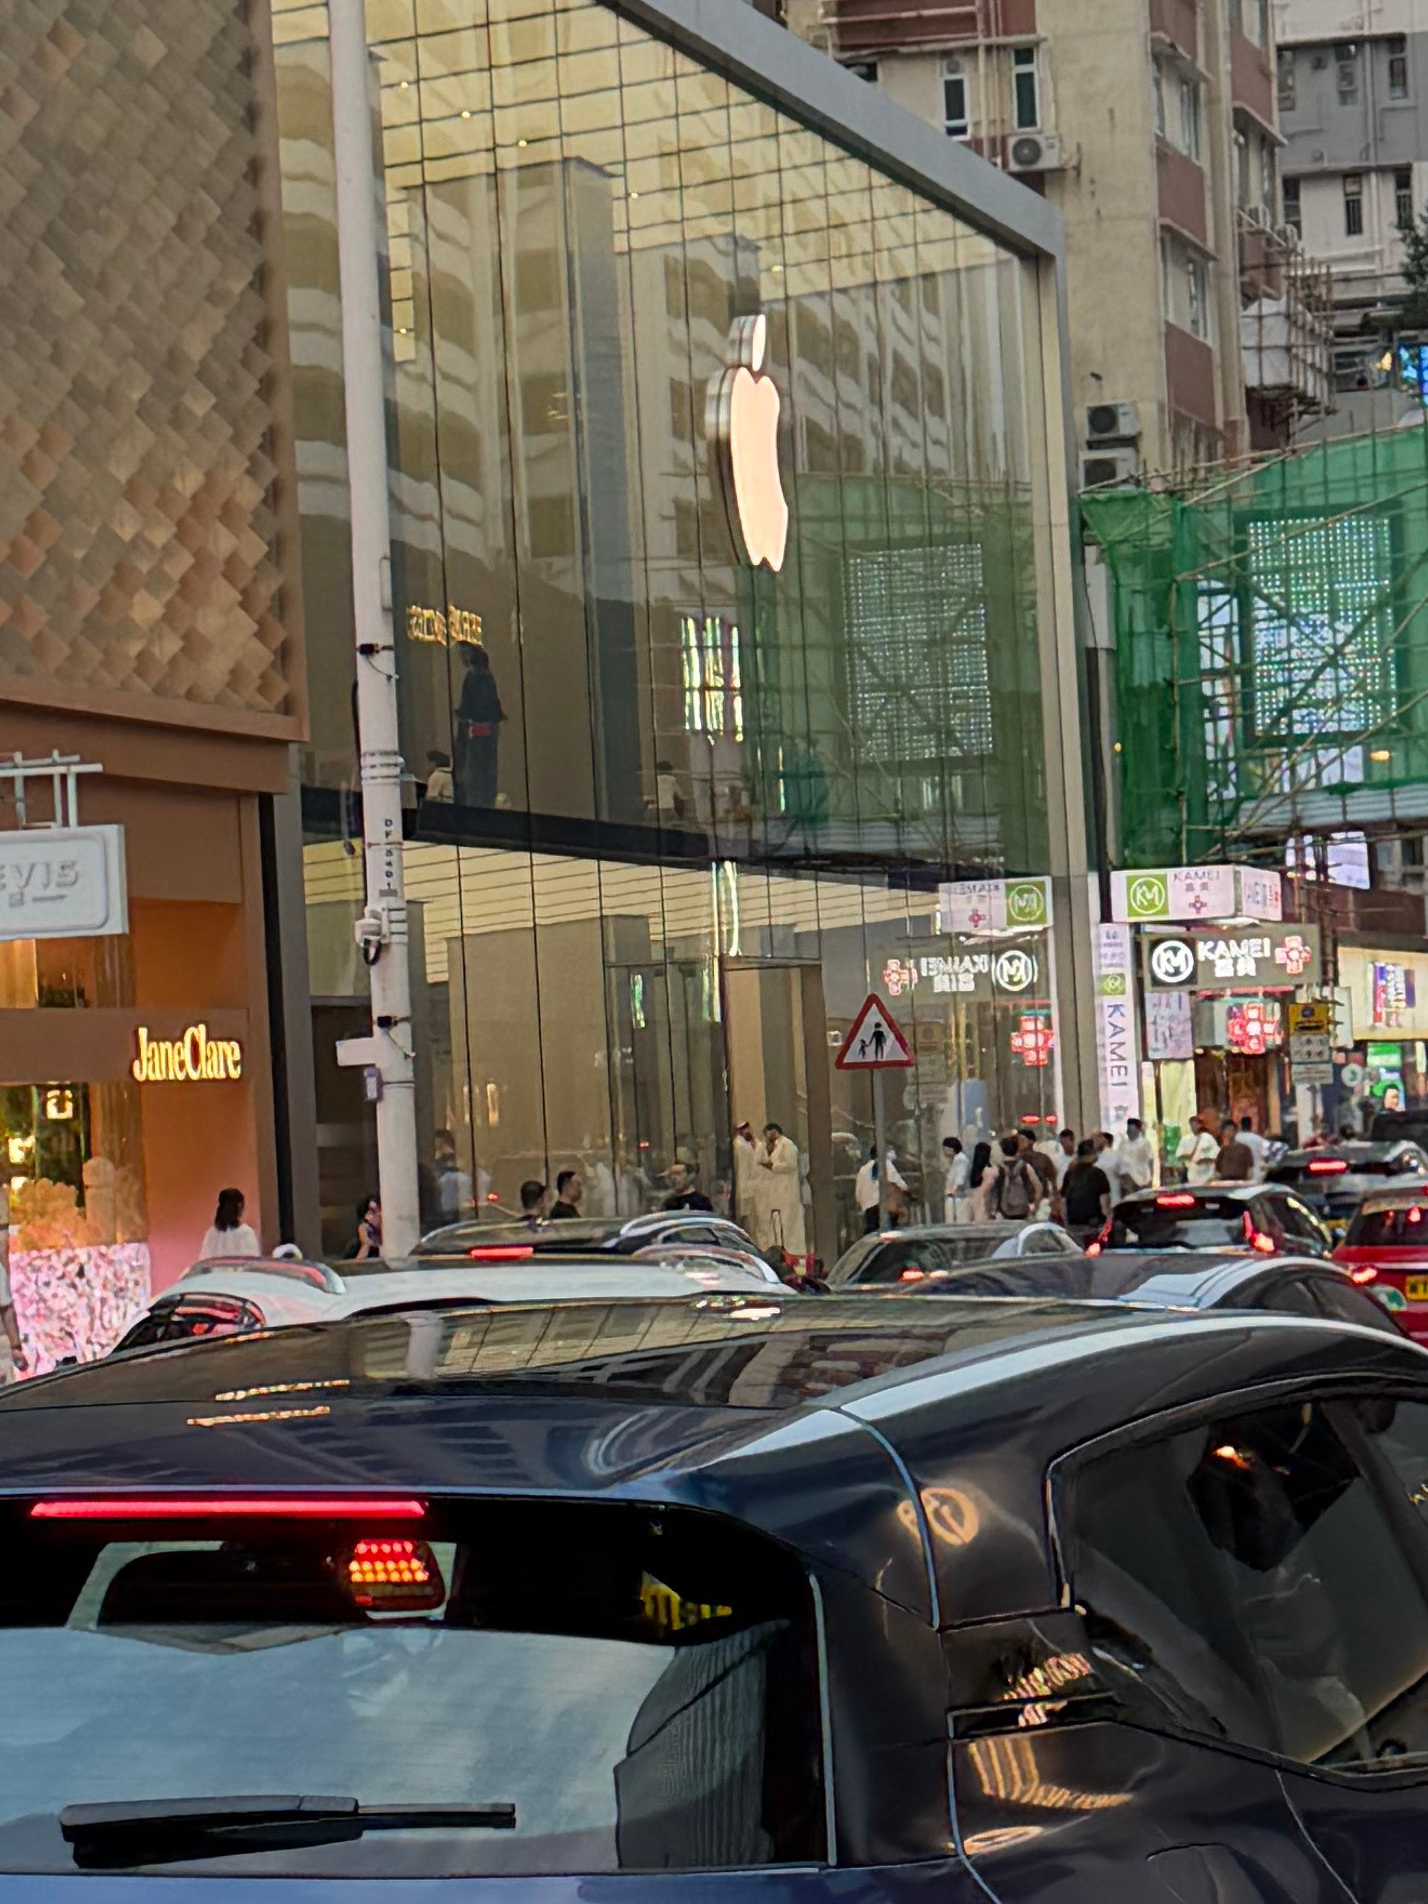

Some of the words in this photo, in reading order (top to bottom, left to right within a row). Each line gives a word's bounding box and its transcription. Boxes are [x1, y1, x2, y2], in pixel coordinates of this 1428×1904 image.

[1172, 870, 1221, 883] KAMEI
[1197, 936, 1272, 962] KAMEI
[133, 1024, 242, 1082] JaneClare
[1106, 1002, 1129, 1089] KAMEI
